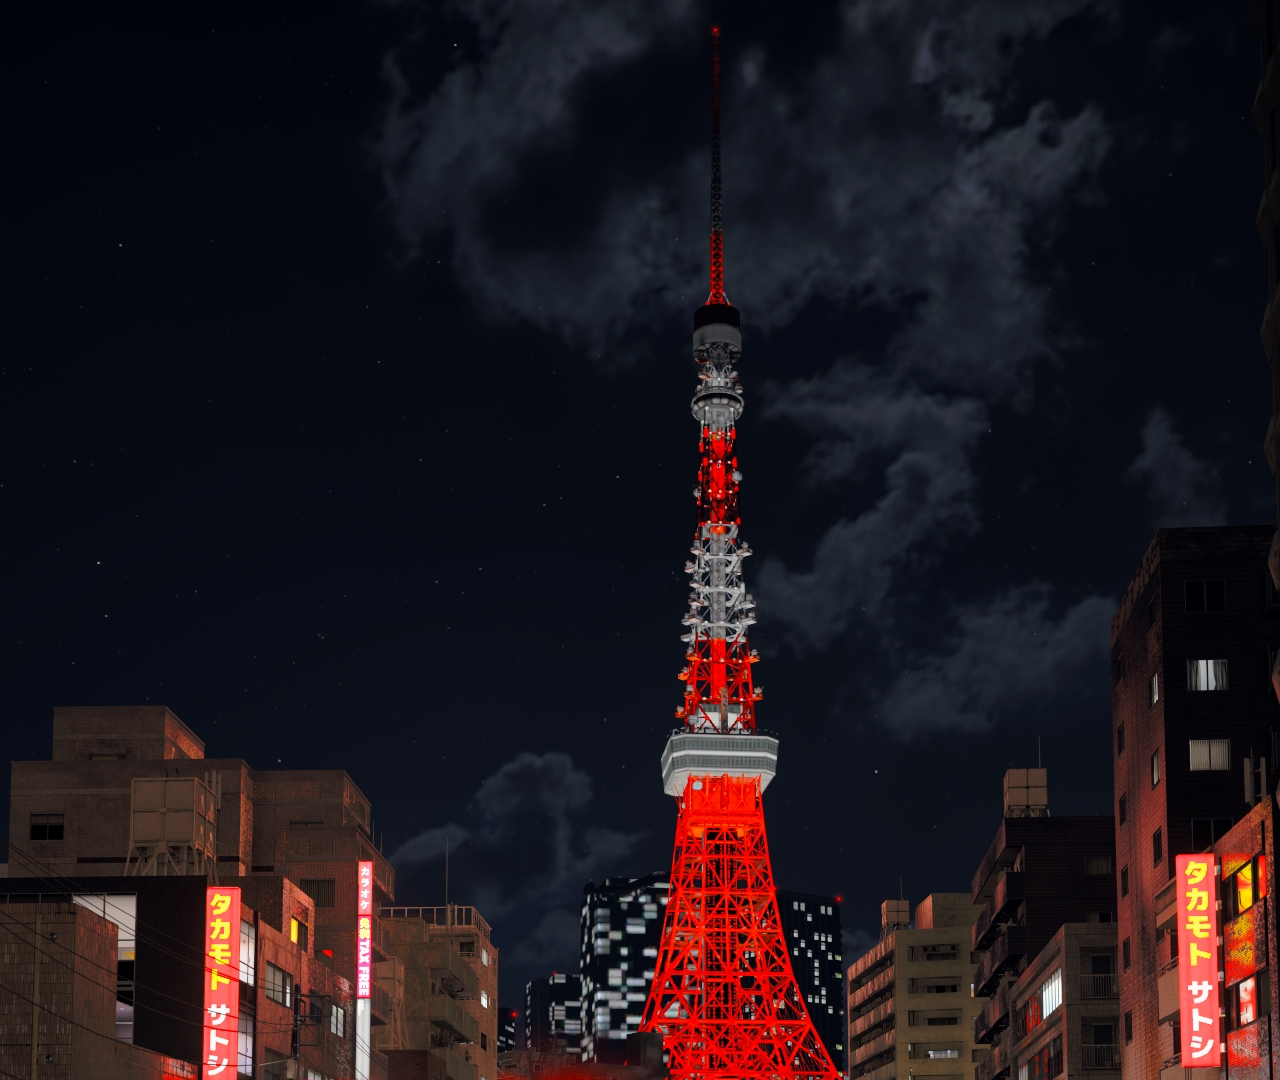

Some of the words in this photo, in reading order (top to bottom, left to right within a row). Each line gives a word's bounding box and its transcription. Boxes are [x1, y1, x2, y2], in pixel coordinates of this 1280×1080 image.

[360, 866, 370, 910] カラオケ
[1185, 860, 1212, 967] タカモト
[208, 893, 232, 991] タカモト
[358, 939, 370, 964] TAX
[358, 966, 370, 996] FREE
[207, 1003, 231, 1077] サトシ
[1187, 980, 1214, 1059] サトシ
